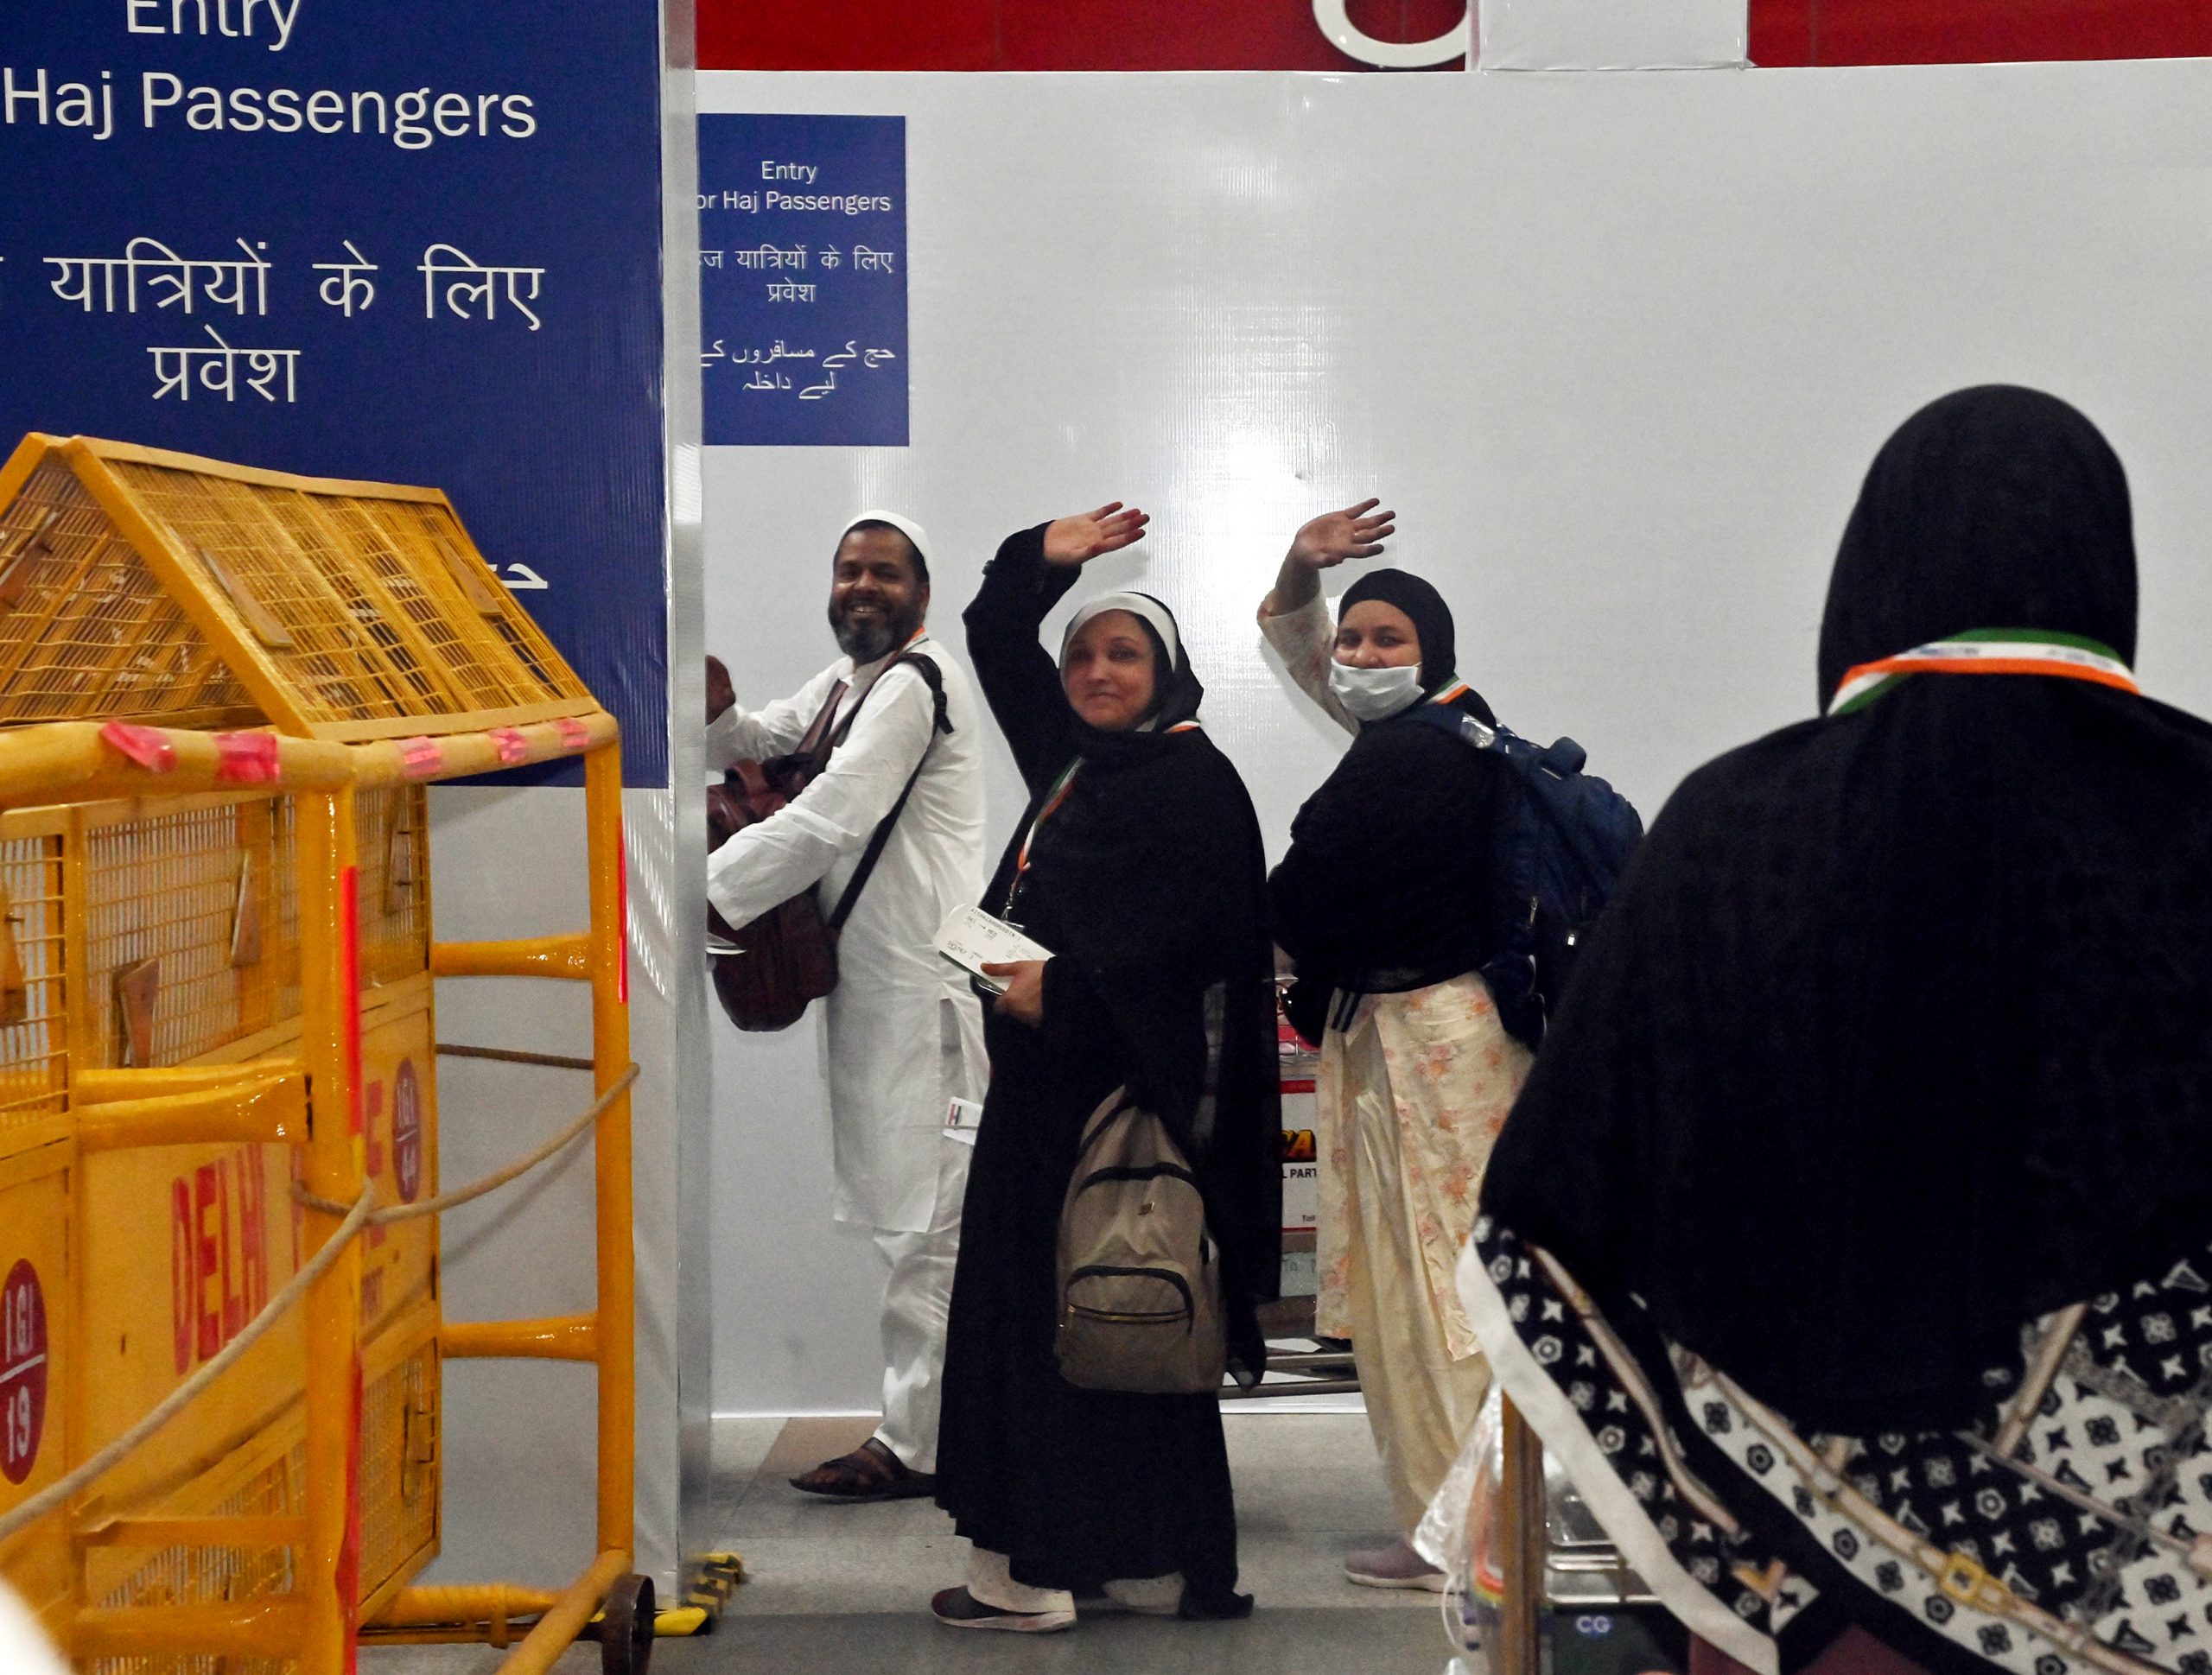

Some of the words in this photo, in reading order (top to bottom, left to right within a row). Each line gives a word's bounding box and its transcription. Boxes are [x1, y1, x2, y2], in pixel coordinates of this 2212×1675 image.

[127, 0, 300, 52] Entry
[3, 67, 114, 140] Haj
[143, 72, 537, 149] Passengers
[761, 161, 817, 185] Entry
[723, 190, 760, 214] Haj
[766, 190, 892, 215] Passengers
[698, 250, 724, 270] ज
[734, 244, 808, 270] यात्रियों
[818, 244, 841, 270] के
[853, 244, 894, 273] लिए
[43, 237, 272, 315] यात्रियों
[312, 239, 378, 317] के
[417, 244, 546, 332] लिए
[766, 276, 817, 302] प्रवेश
[147, 324, 302, 403] प्रवेश
[864, 348, 896, 368] حج
[7, 1385, 31, 1463] 19
